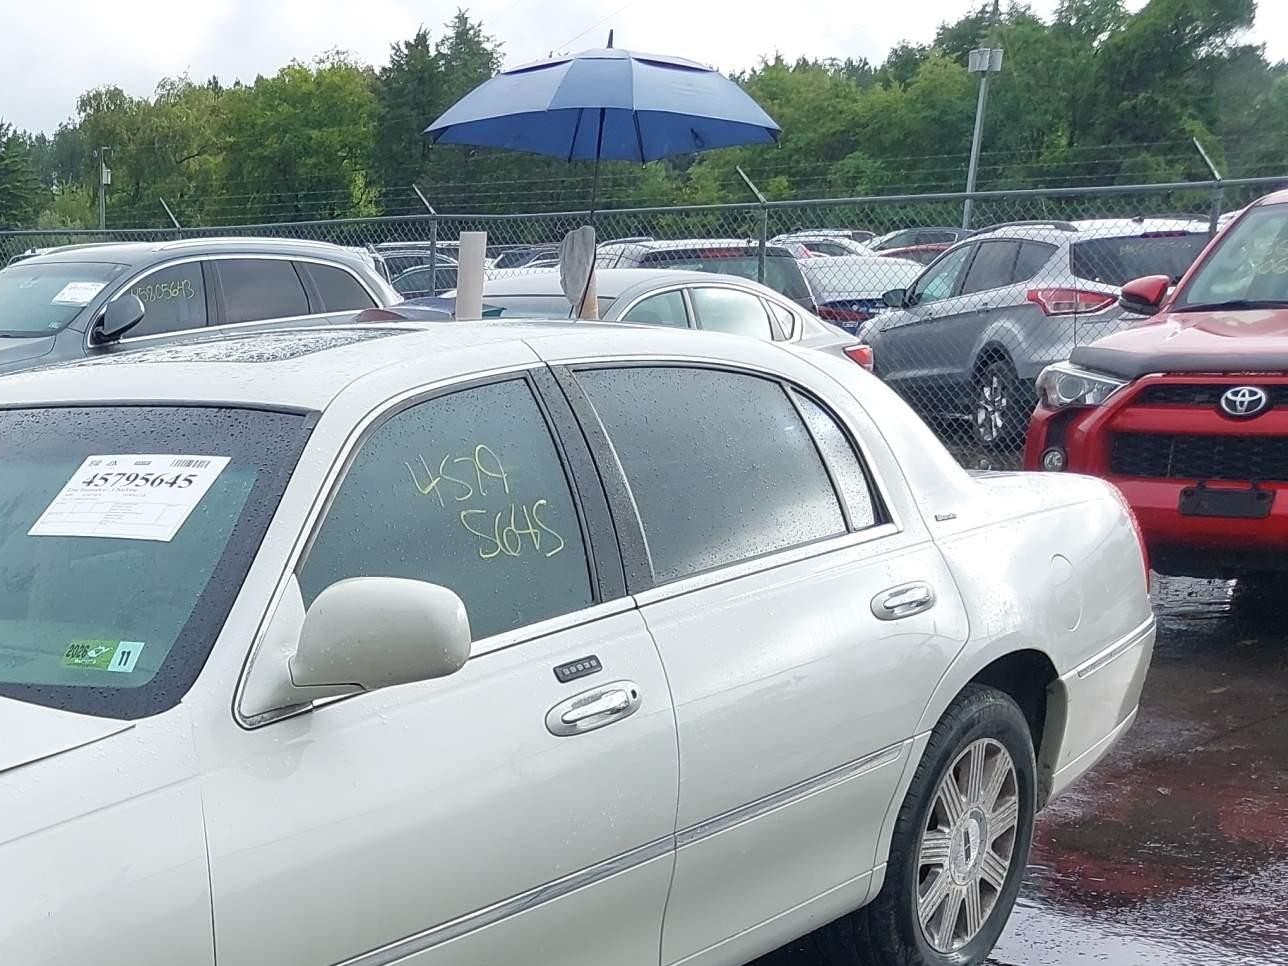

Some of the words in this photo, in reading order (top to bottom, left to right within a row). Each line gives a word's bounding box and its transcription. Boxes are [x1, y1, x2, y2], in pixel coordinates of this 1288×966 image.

[80, 472, 198, 489] 45795645
[461, 500, 564, 558] 5645
[65, 643, 90, 658] 2026
[118, 650, 131, 667] 11
